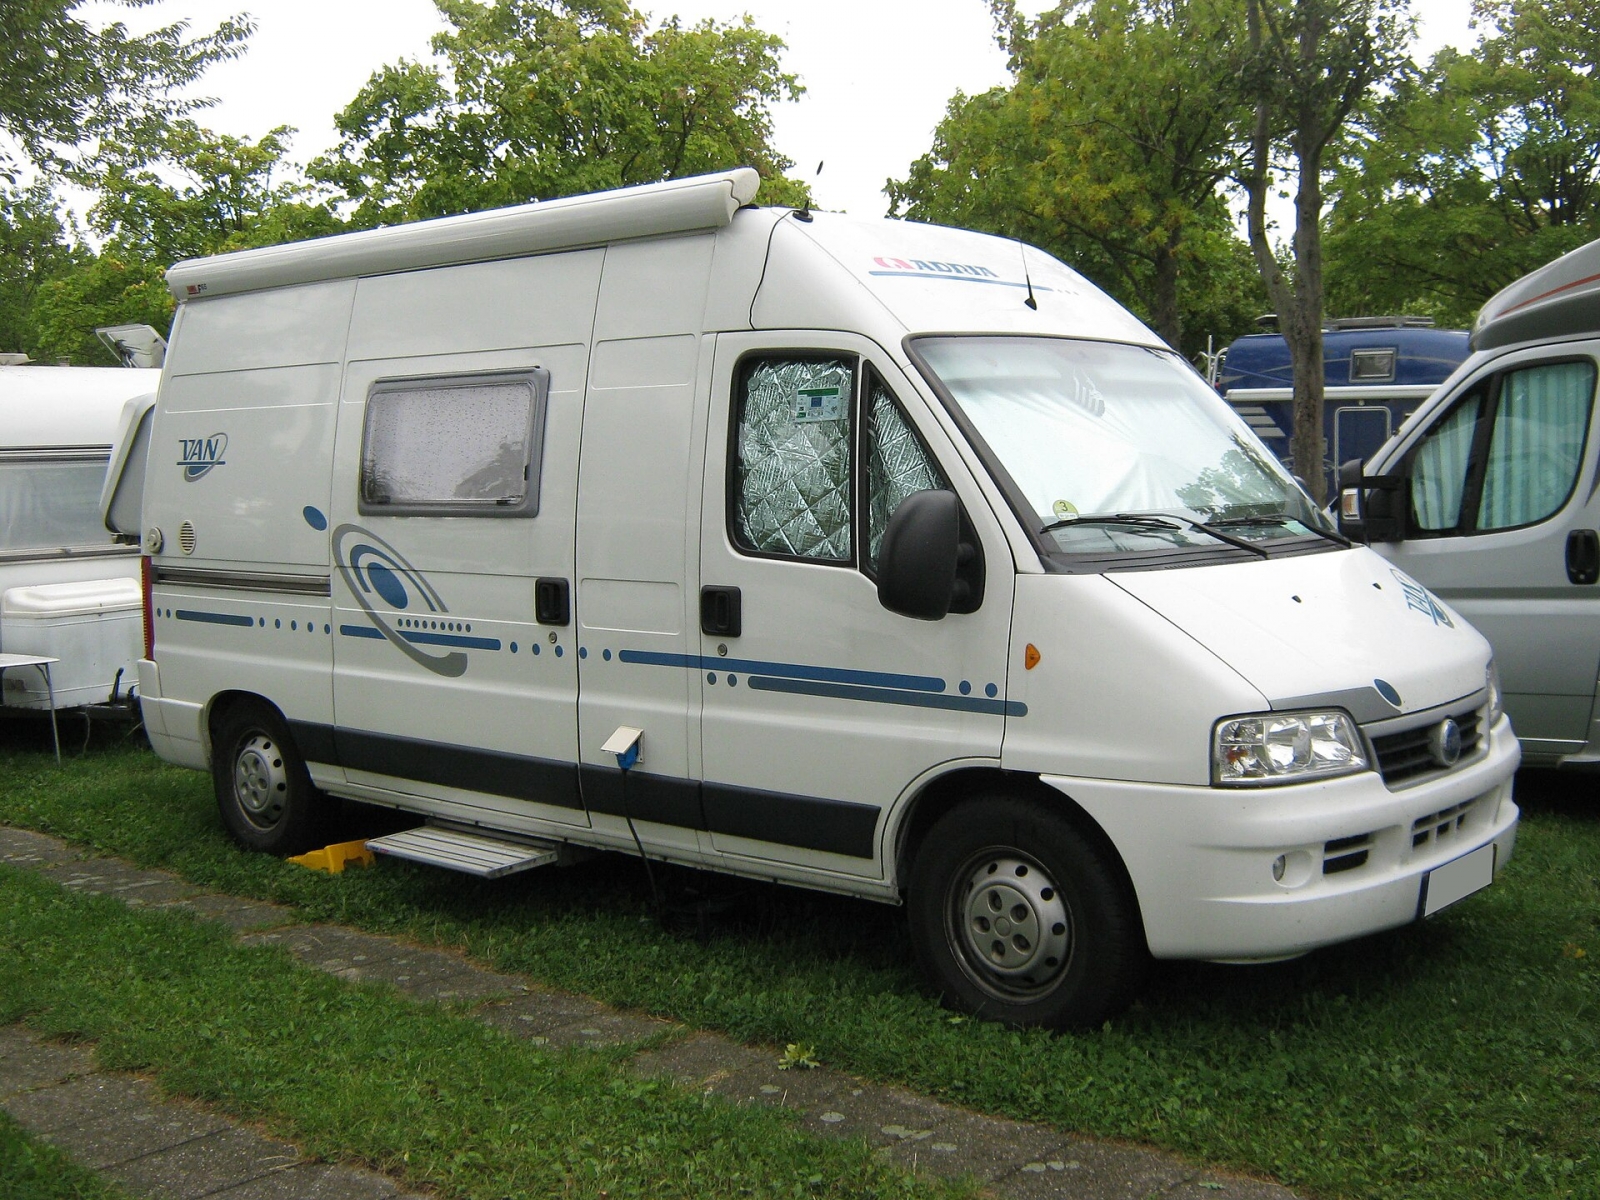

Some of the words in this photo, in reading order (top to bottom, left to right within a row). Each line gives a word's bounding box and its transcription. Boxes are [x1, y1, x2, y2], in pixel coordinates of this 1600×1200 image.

[909, 259, 999, 277] ADRIA
[178, 438, 219, 461] VAN
[1059, 501, 1068, 511] 3
